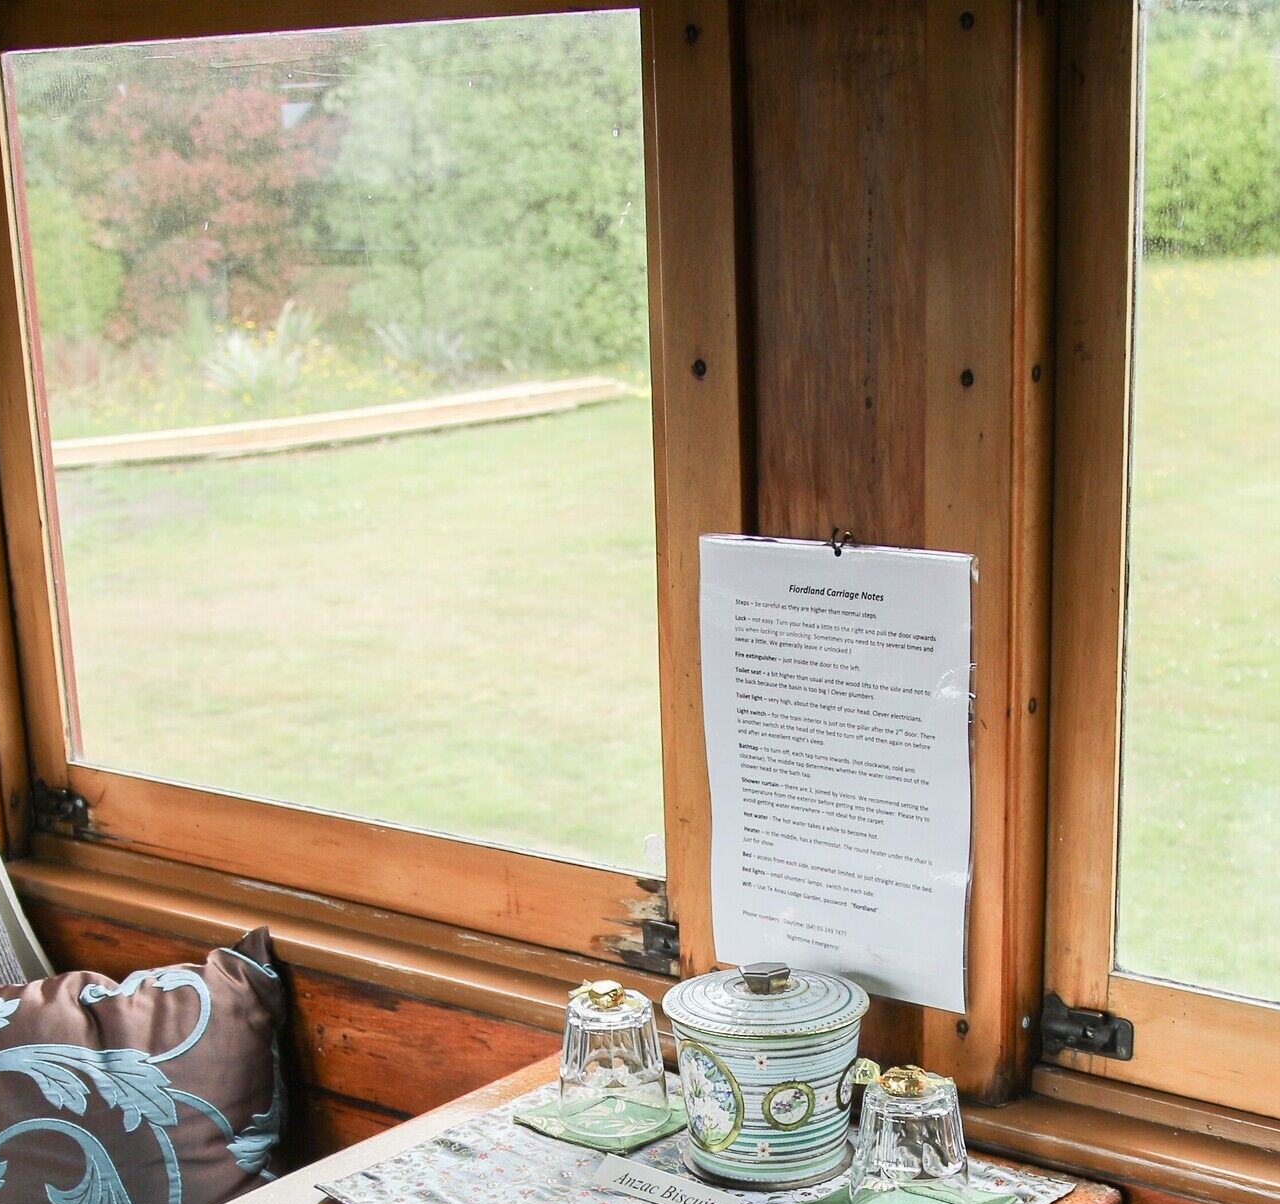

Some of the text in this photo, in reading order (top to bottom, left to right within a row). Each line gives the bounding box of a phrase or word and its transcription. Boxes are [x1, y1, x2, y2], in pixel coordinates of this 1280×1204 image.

[789, 584, 884, 601] Fiordland Carriage Notes
[736, 599, 749, 607] Steps
[787, 603, 800, 612] they
[810, 605, 827, 614] higher
[828, 607, 841, 615] than
[736, 614, 747, 622] Lock
[802, 621, 815, 629] head
[851, 626, 864, 635] right
[876, 629, 887, 637] pull
[898, 631, 911, 639] door
[912, 634, 936, 642] upwards
[760, 627, 778, 637] locking
[877, 641, 885, 649] try
[779, 642, 803, 650] generally
[803, 643, 818, 651] leave
[823, 646, 848, 654] unlocked
[745, 653, 777, 662] extinguisher
[782, 656, 792, 664] just
[793, 658, 809, 666] inside
[819, 660, 832, 668] door
[736, 666, 750, 674] Toilet
[779, 671, 795, 680] higher
[796, 673, 808, 681] than
[835, 678, 844, 686] the
[861, 681, 872, 689] lifts
[744, 677, 756, 685] back
[757, 679, 778, 688] because
[788, 683, 802, 691] basin
[818, 687, 826, 695] big
[830, 689, 847, 697] Clever
[751, 693, 763, 702] light
[768, 697, 779, 705] very
[793, 699, 809, 707] about
[819, 702, 836, 712] height
[872, 710, 889, 718] Clever
[737, 707, 749, 715] Light
[803, 716, 822, 725] interior
[871, 725, 884, 733] after
[920, 732, 936, 740] There
[762, 721, 779, 729] switch
[795, 725, 808, 733] head
[825, 729, 836, 737] bed
[912, 741, 931, 750] before
[805, 752, 814, 760] tap
[741, 762, 772, 772] shower head
[777, 758, 795, 766] middle
[795, 761, 804, 769] tap
[805, 761, 834, 772] determines
[835, 766, 857, 775] whether
[742, 776, 760, 785] Shower
[784, 783, 799, 791] there
[814, 788, 831, 796] joined
[900, 803, 919, 811] setting
[743, 787, 773, 797] temperature
[817, 798, 834, 806] before
[835, 802, 854, 811] getting
[898, 811, 914, 820] Please
[915, 815, 923, 823] try
[757, 799, 775, 808] getting
[791, 805, 820, 814] everywhere
[835, 811, 848, 819] ideal
[744, 810, 753, 818] Hot
[807, 822, 821, 830] takes
[847, 828, 867, 838] become
[744, 825, 761, 834] Heater
[752, 867, 765, 876] lights
[742, 880, 752, 888] Wifi
[823, 898, 847, 907] password
[895, 881, 911, 889] across
[613, 1172, 660, 1195] Anzac
